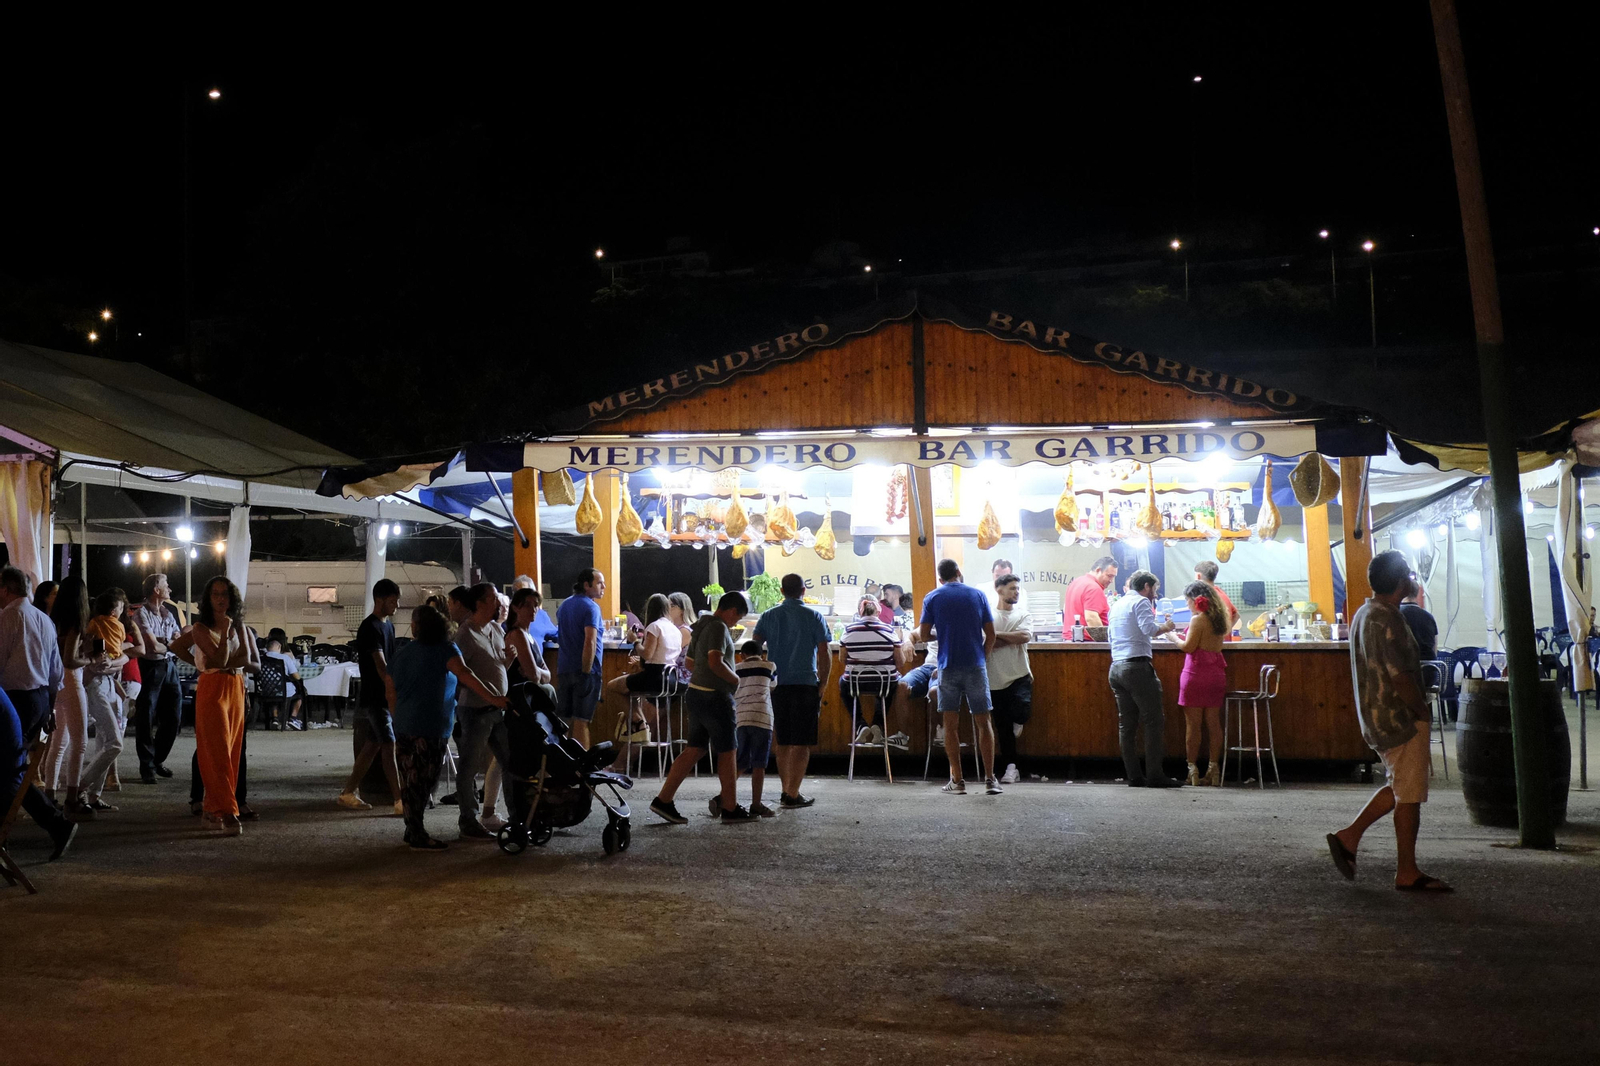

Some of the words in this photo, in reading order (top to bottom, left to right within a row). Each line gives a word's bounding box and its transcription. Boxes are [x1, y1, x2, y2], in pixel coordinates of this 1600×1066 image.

[588, 323, 829, 418] MERENDERO
[986, 310, 1071, 349] BAR
[1094, 341, 1297, 407] GARRIDO
[569, 442, 856, 466] MERENDERO
[918, 439, 1013, 460] BAR
[1034, 430, 1266, 459] GARRIDO
[820, 574, 831, 586] A
[837, 573, 858, 586] LA
[1023, 571, 1036, 583] EN
